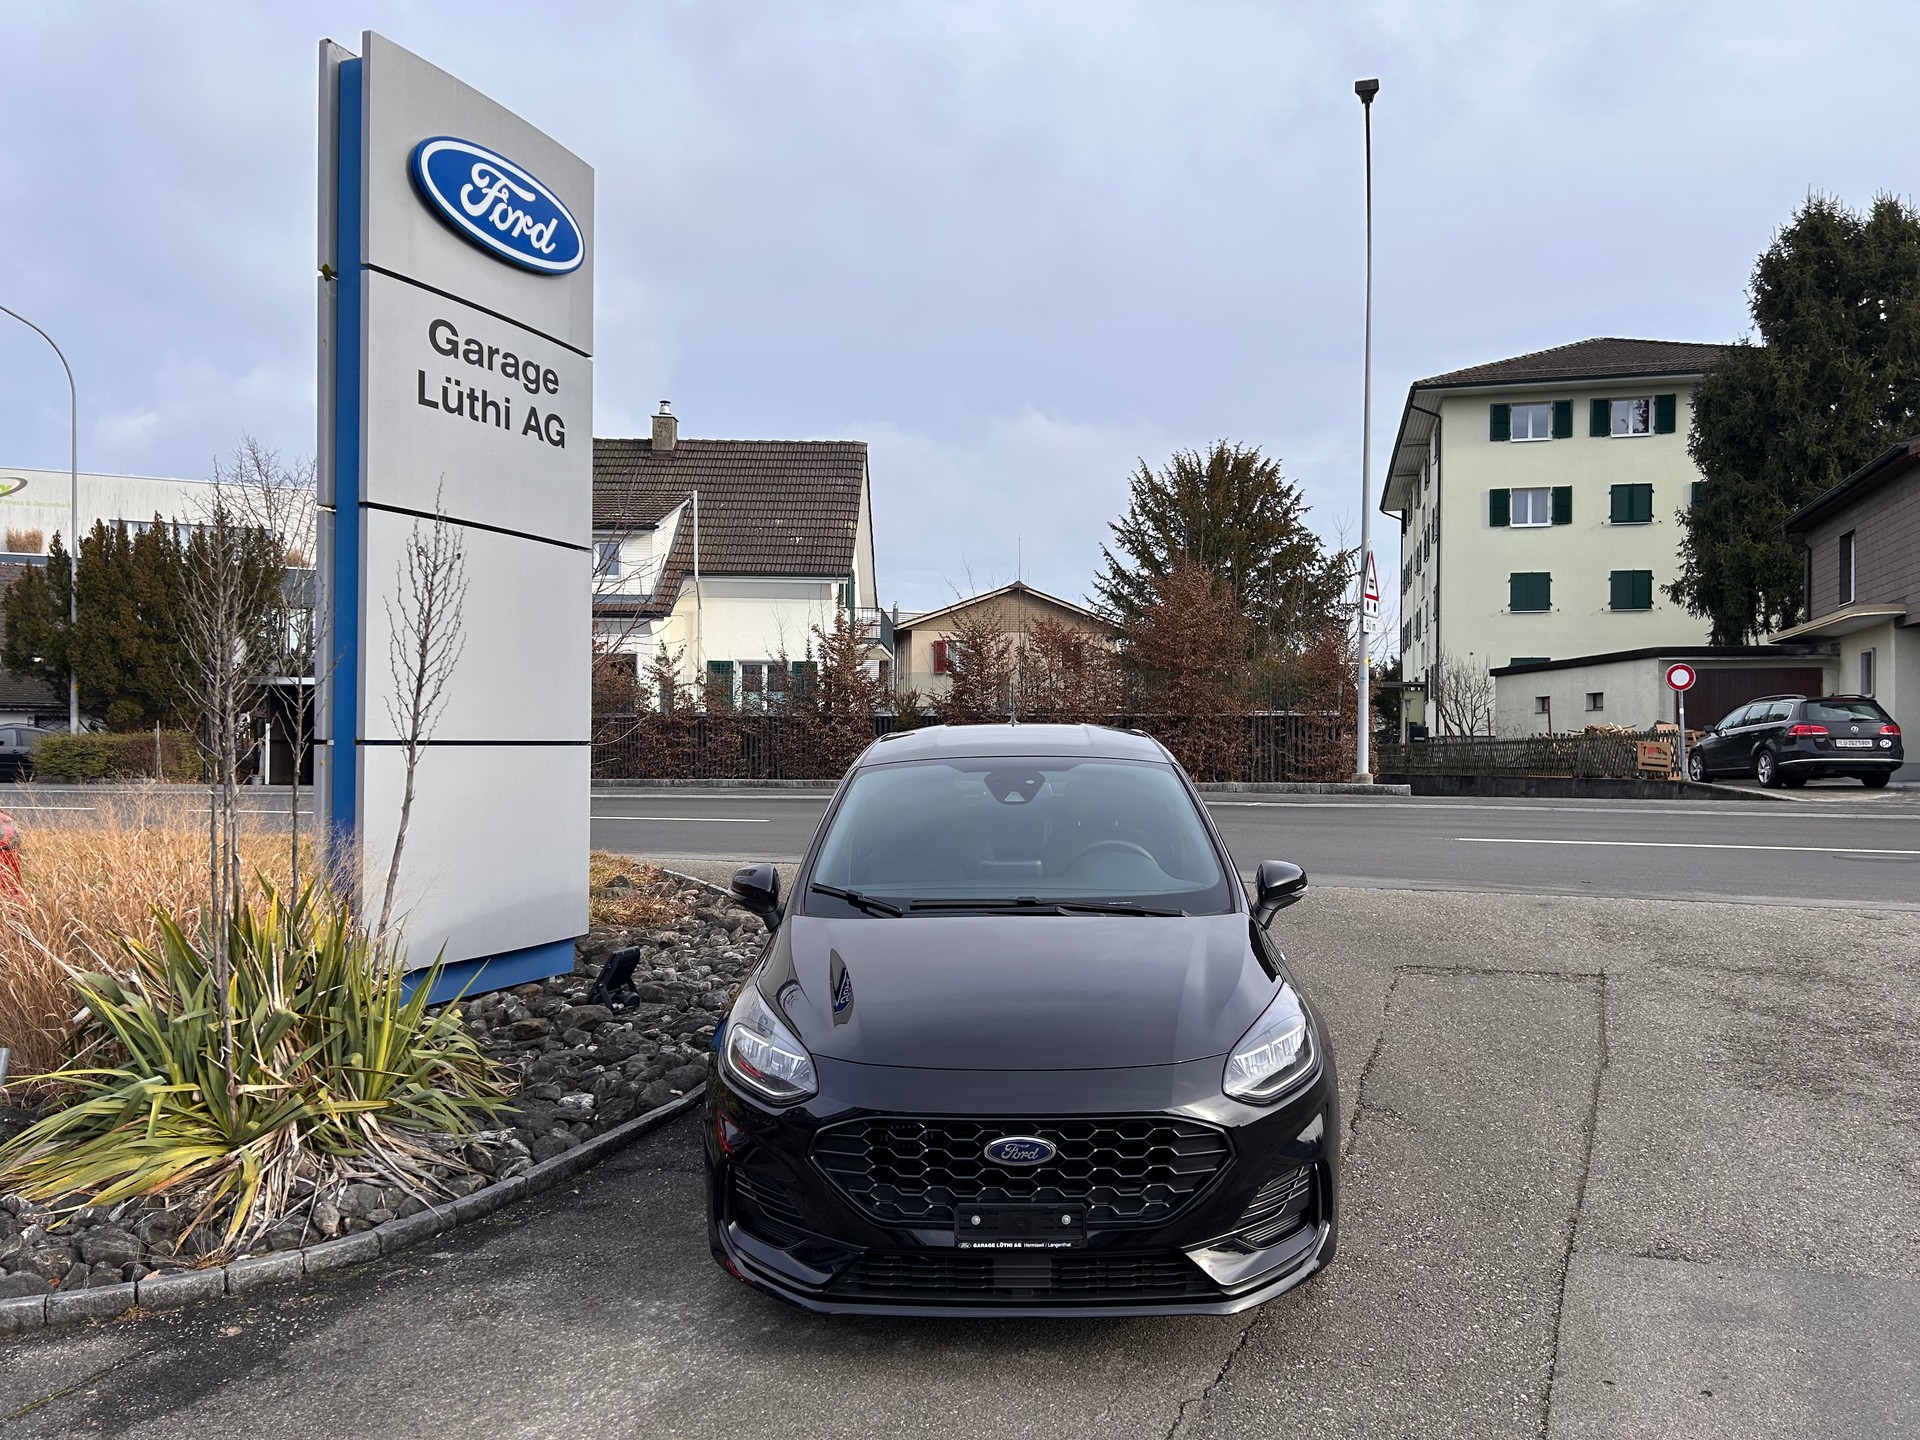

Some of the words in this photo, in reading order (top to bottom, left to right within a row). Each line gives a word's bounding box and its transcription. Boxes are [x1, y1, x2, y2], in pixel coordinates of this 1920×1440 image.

[460, 162, 556, 254] Ford
[428, 318, 559, 395] Garage
[417, 369, 511, 430] Lüthi
[522, 405, 566, 448] AG
[1001, 1143, 1039, 1160] Ford
